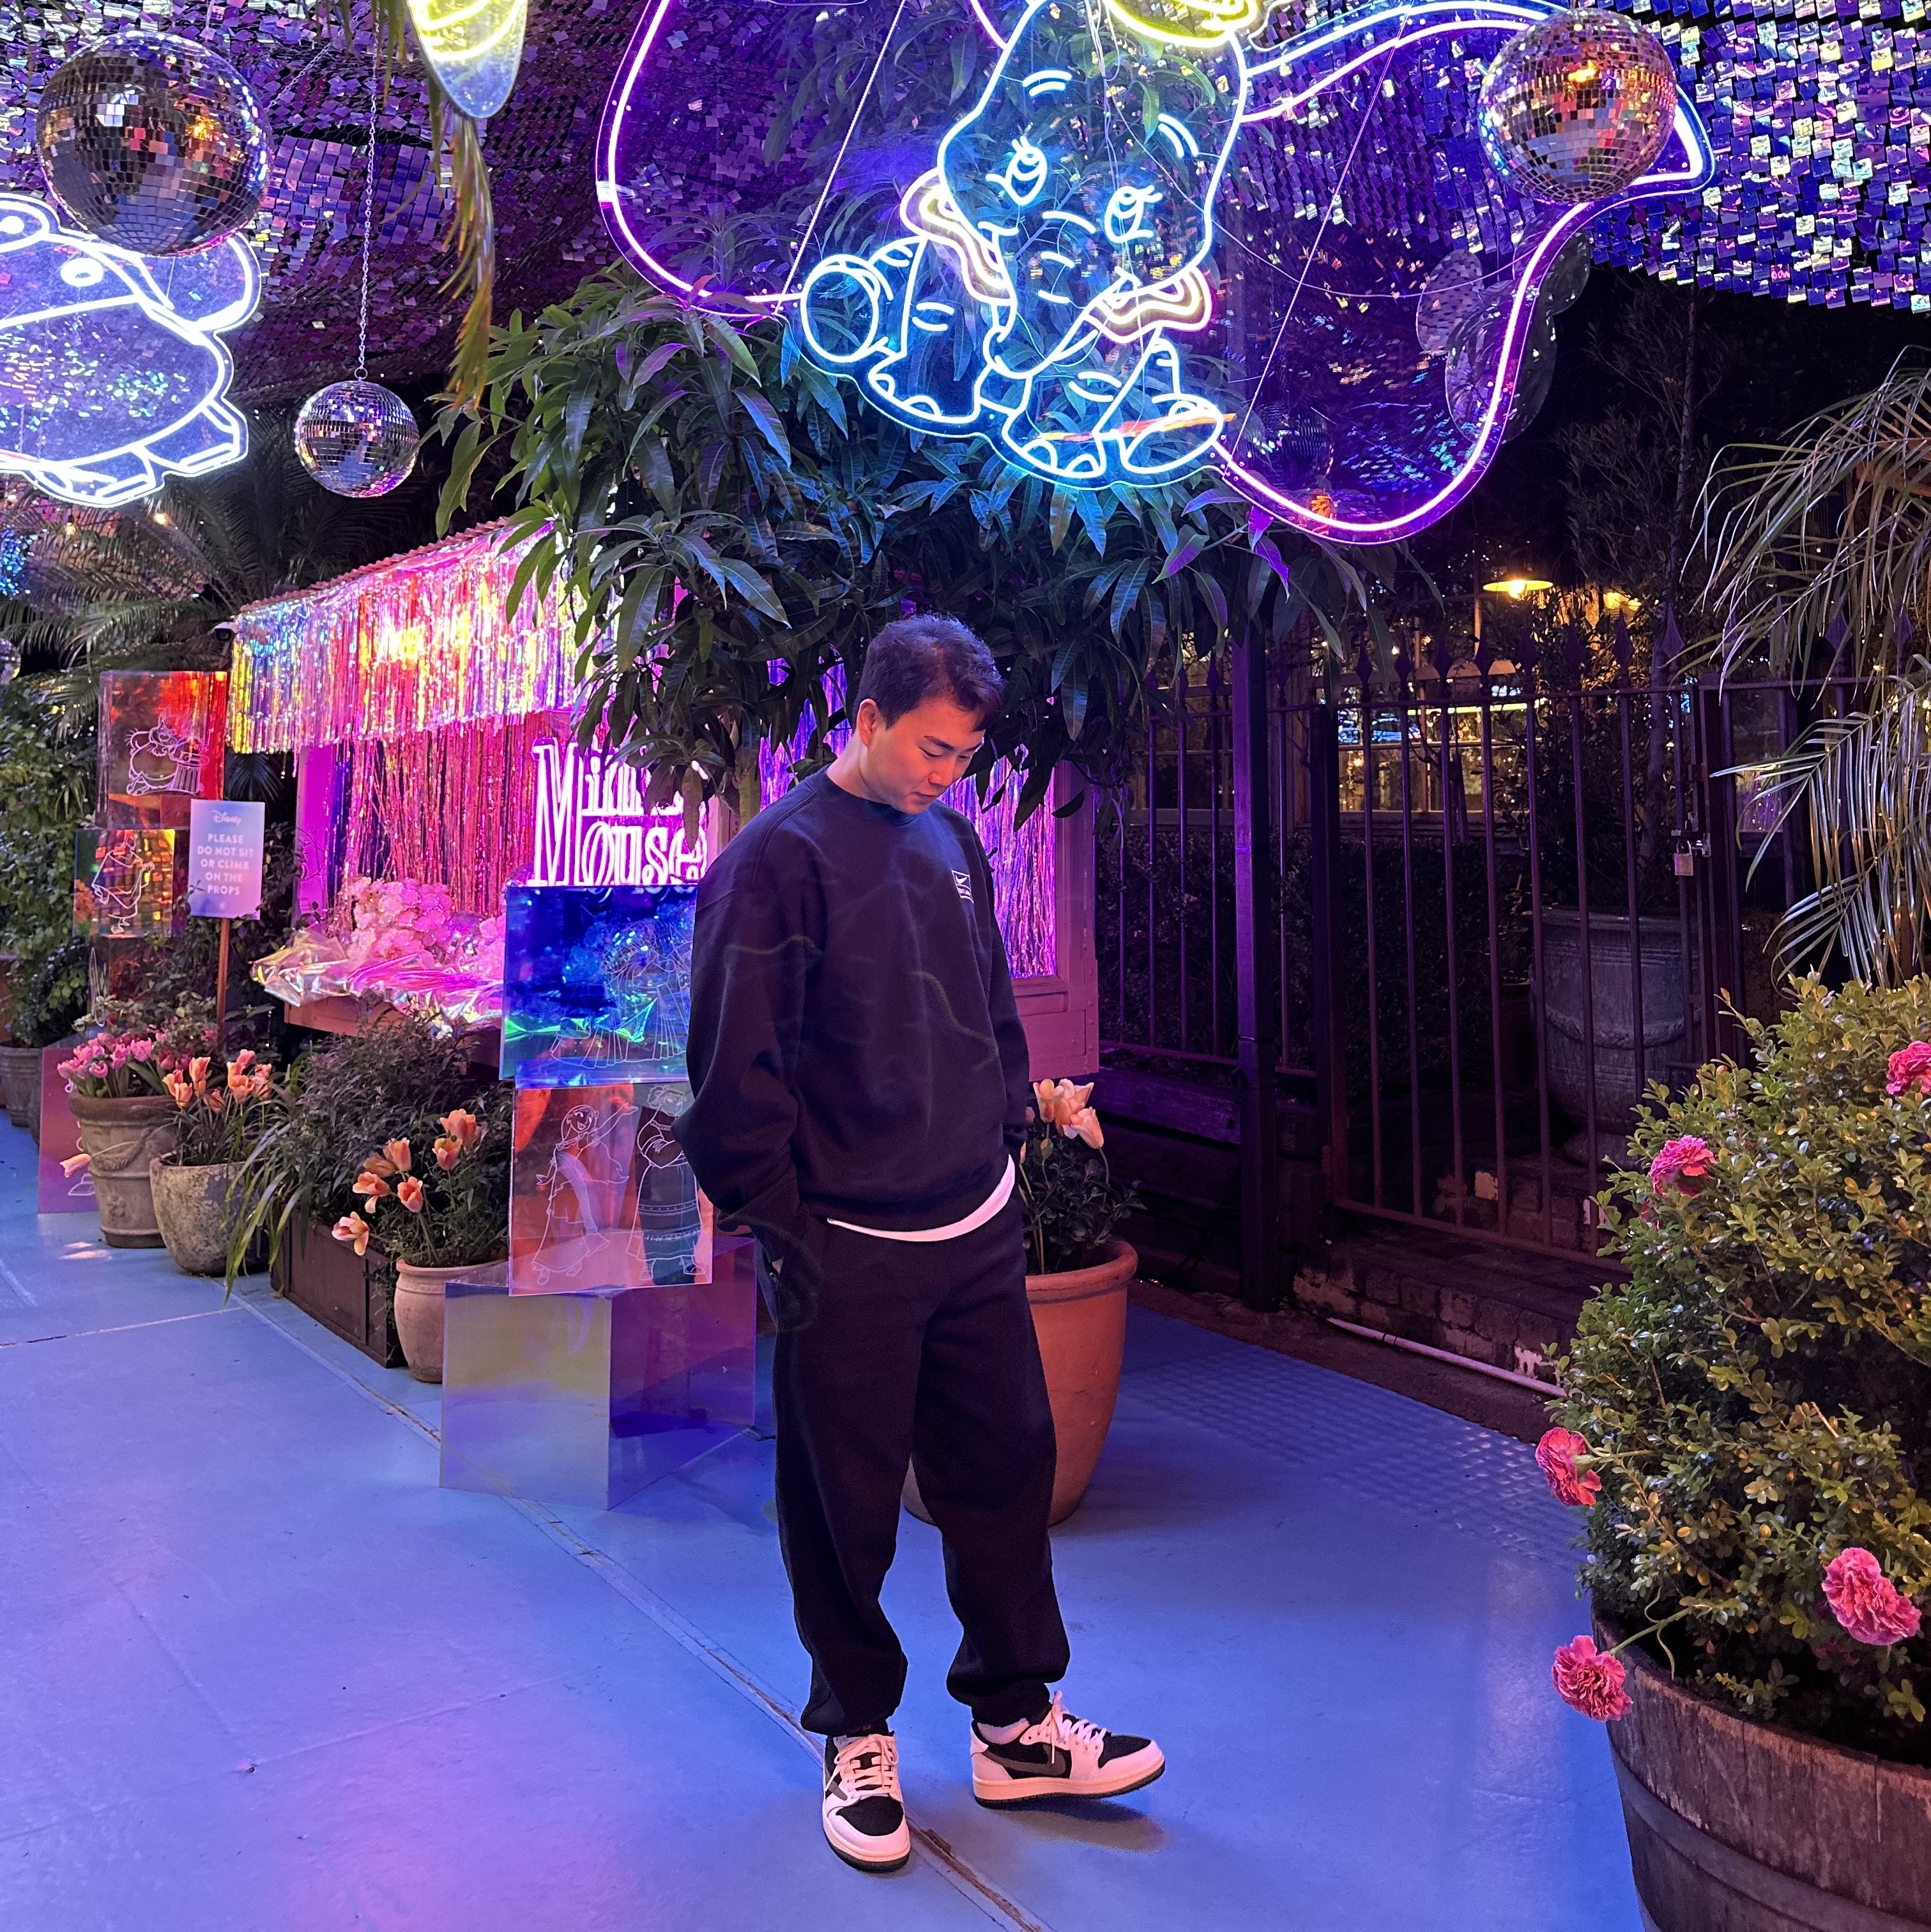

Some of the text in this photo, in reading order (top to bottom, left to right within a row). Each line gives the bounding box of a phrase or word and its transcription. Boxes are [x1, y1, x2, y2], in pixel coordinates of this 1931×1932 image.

[208, 833, 244, 844] PLEASE
[197, 846, 255, 857] DO NOT SIT
[200, 859, 250, 870] OR CLIMB
[205, 871, 243, 883] ON THE
[207, 885, 240, 896] PROPS
